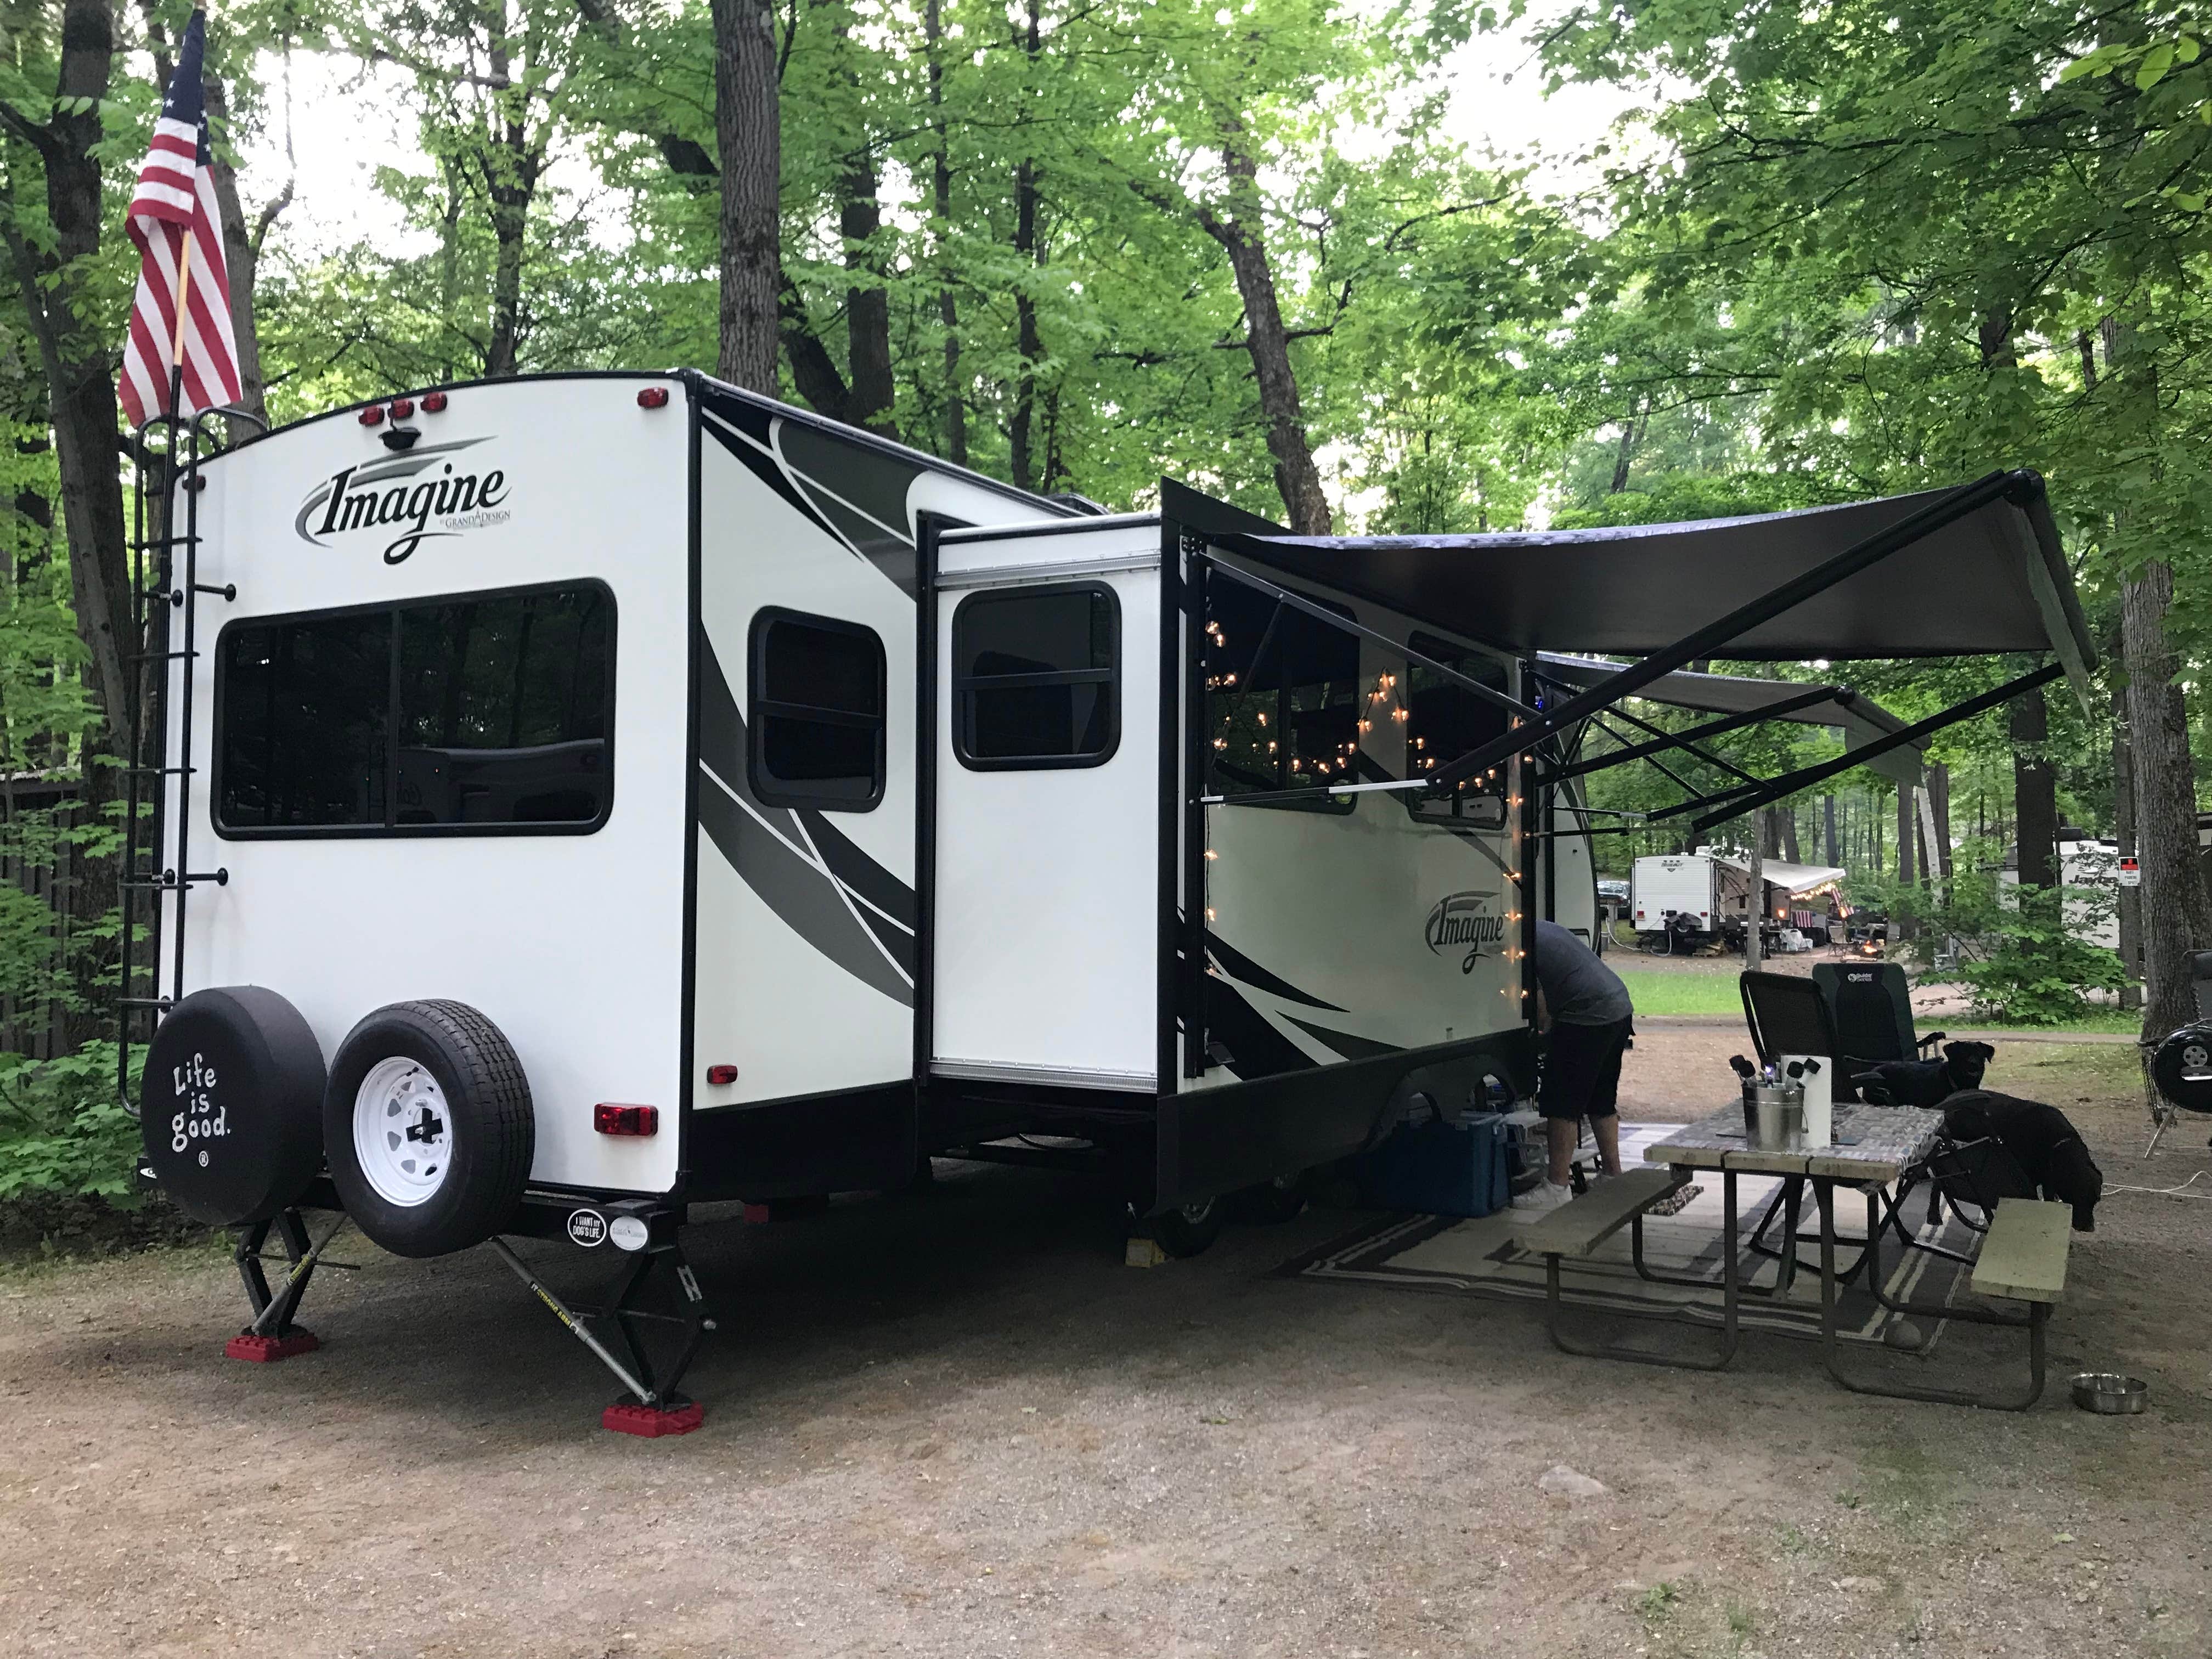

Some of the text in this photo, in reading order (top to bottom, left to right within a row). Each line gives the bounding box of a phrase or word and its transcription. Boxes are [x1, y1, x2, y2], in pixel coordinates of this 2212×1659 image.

[314, 463, 512, 565] Imagine
[1434, 895, 1504, 974] Imagine
[173, 1052, 216, 1096] Life
[191, 1091, 210, 1114] is
[172, 1105, 230, 1152] good.
[573, 1225, 589, 1237] DOG'S
[579, 1216, 593, 1227] WANT
[537, 1289, 558, 1313] STRONG
[557, 1311, 571, 1326] ARM
